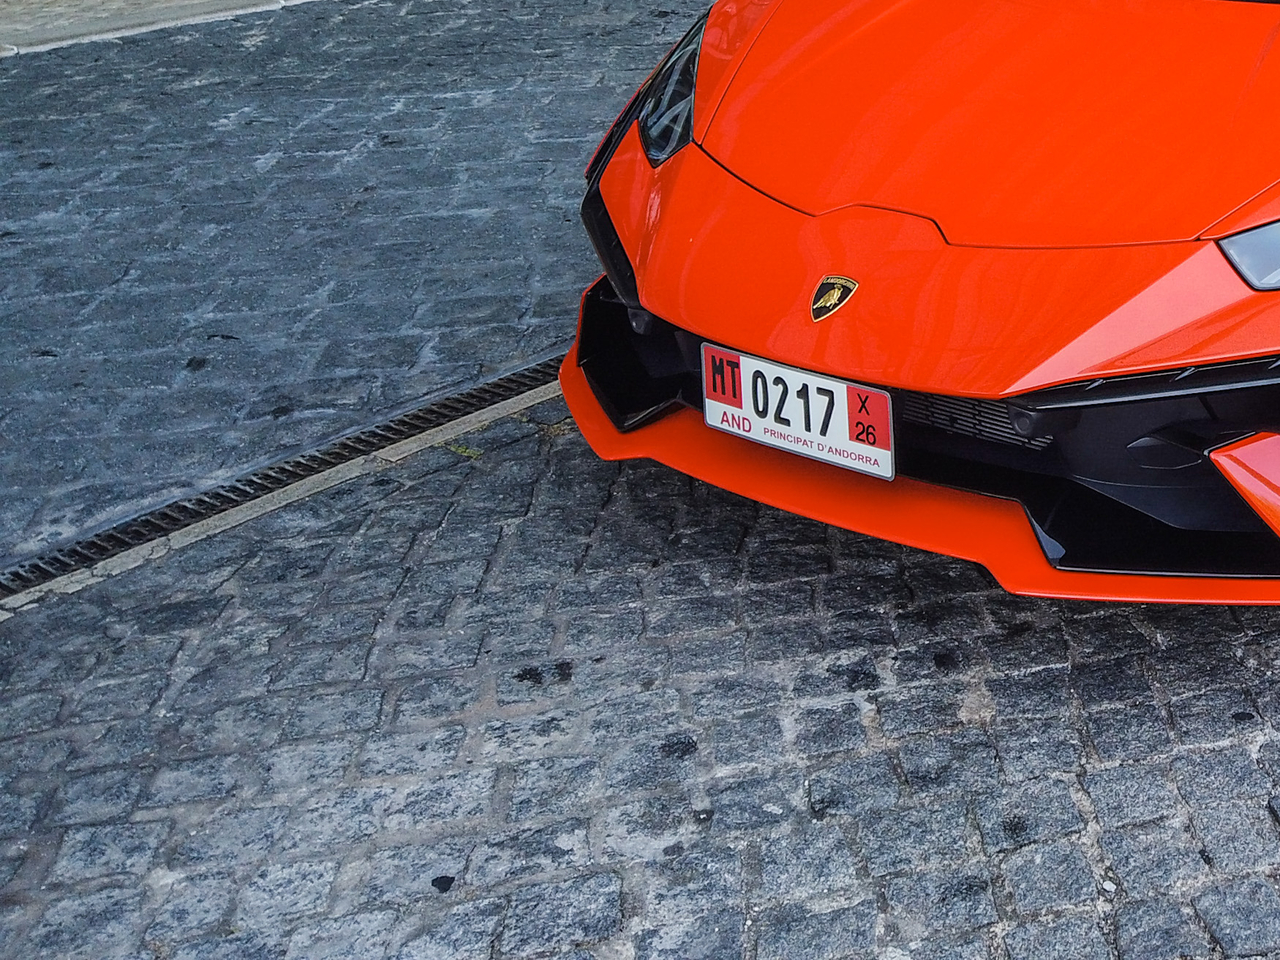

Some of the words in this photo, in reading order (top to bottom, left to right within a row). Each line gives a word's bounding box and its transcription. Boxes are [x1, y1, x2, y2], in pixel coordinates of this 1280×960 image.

[711, 355, 739, 399] MT
[752, 369, 836, 437] 0217
[857, 393, 871, 416] X
[720, 411, 752, 433] AND
[763, 427, 814, 449] PRINCIPAT
[817, 443, 880, 468] D'ANDORRA
[855, 421, 876, 445] 26
